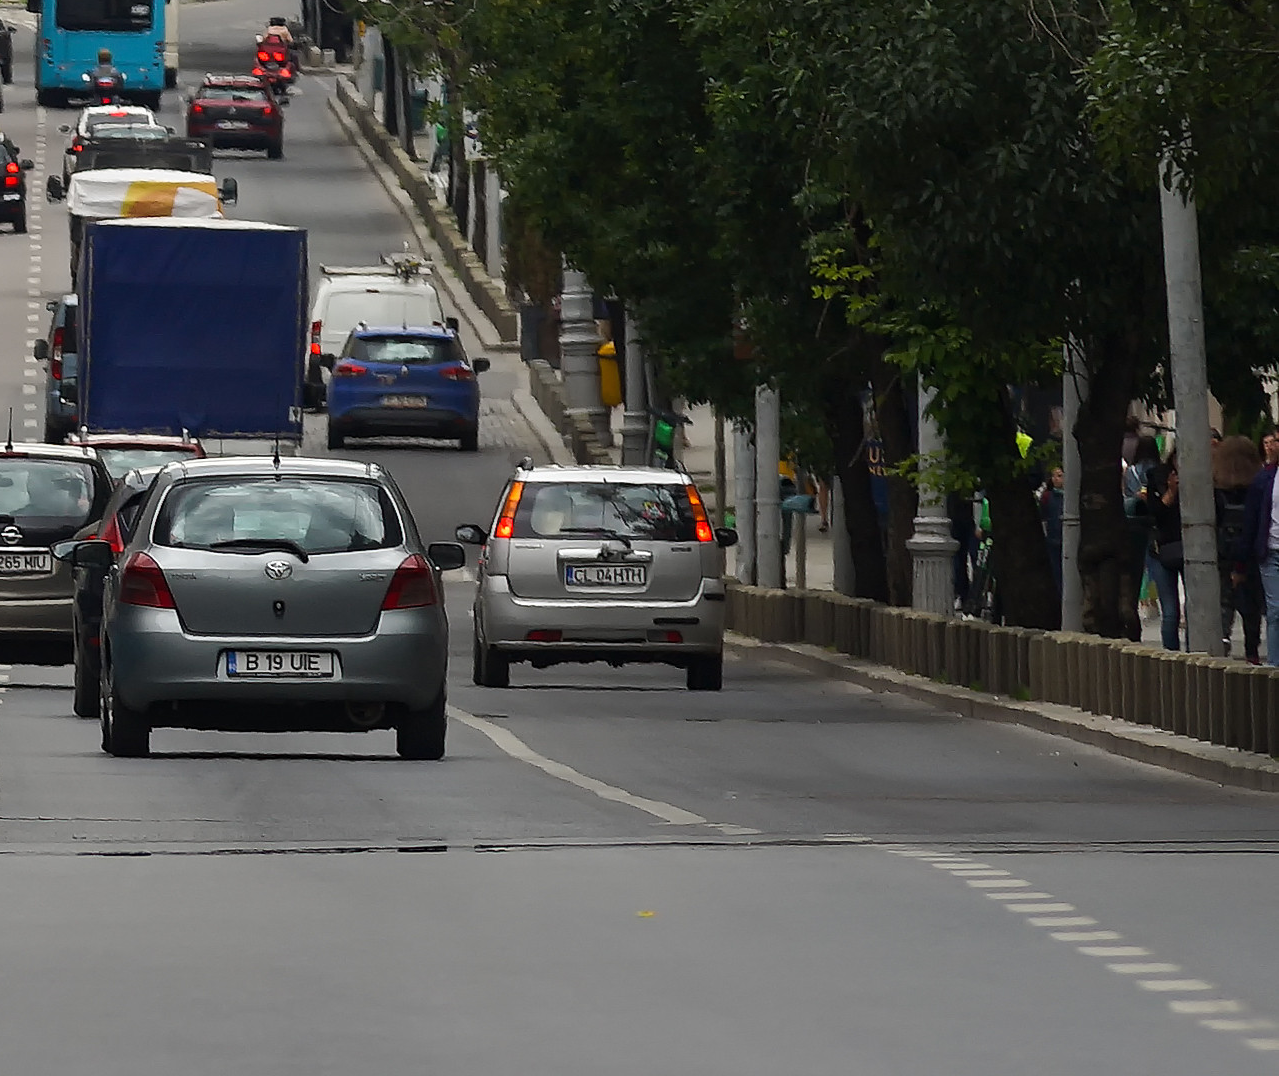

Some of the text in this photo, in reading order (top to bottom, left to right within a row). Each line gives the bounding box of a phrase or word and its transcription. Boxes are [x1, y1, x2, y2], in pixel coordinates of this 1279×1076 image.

[573, 569, 593, 584] CL
[246, 653, 321, 671] B 19 UIE
